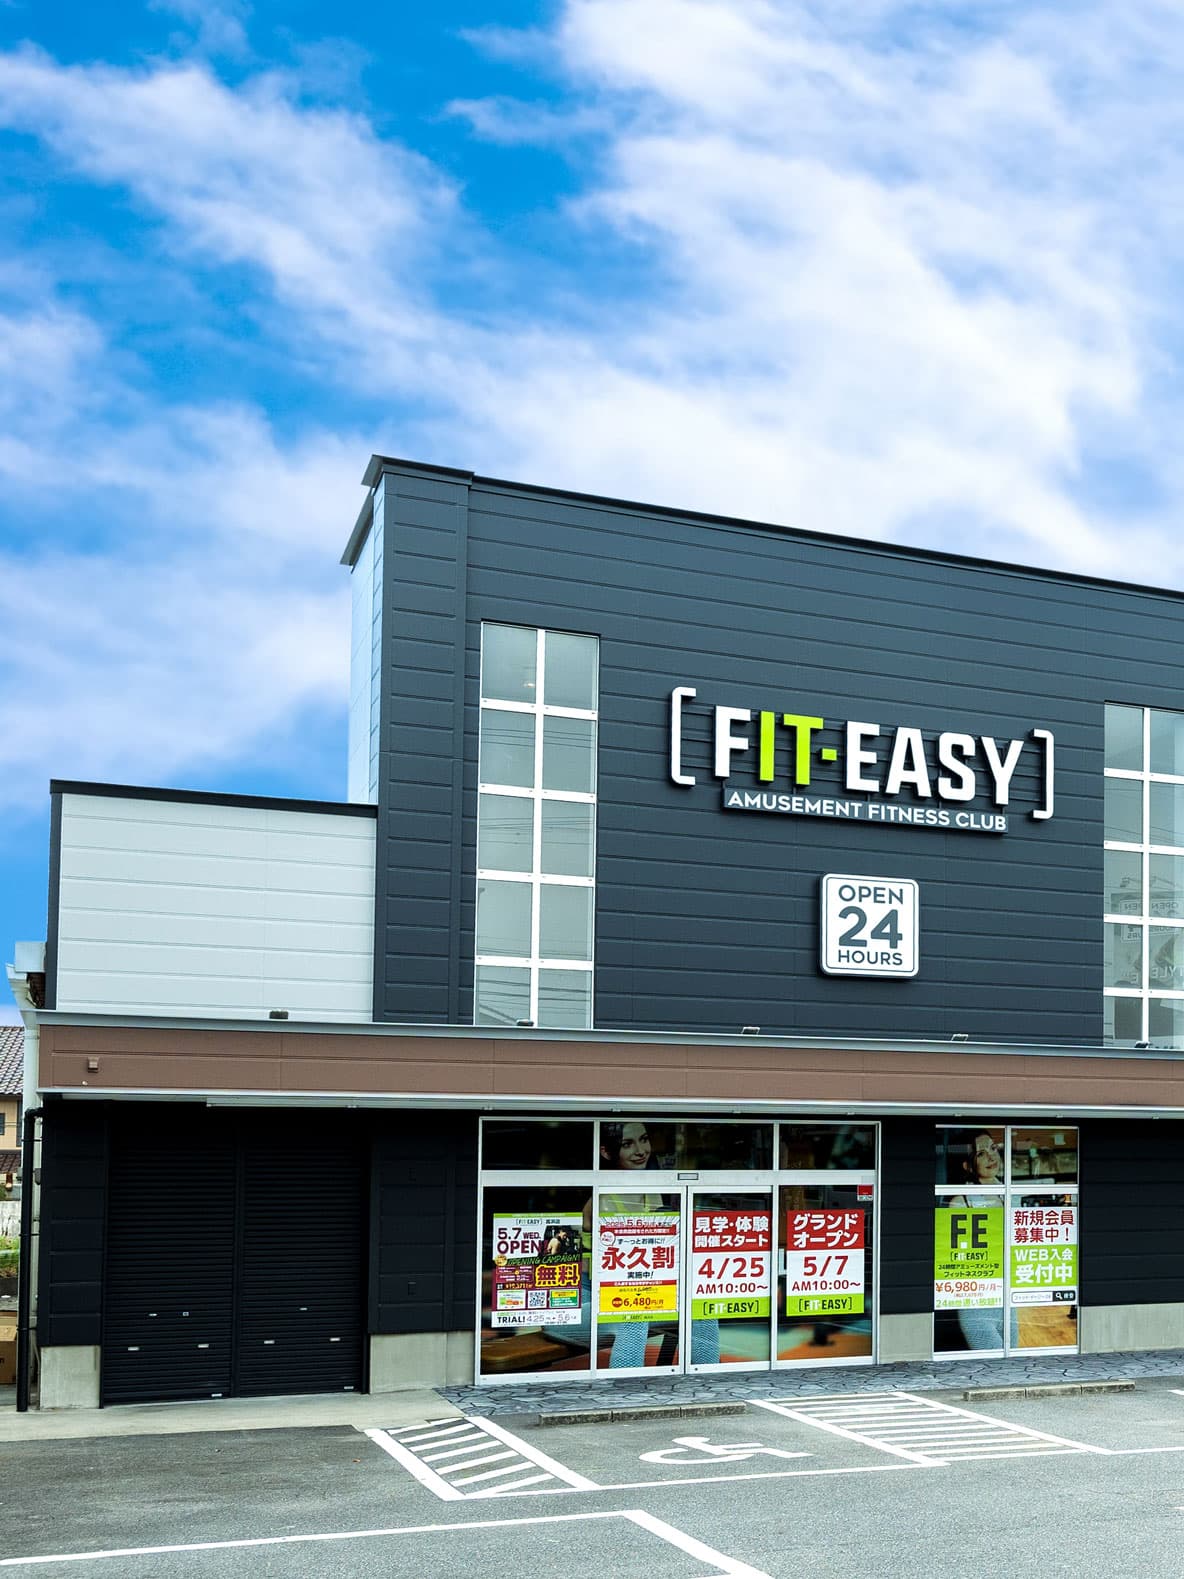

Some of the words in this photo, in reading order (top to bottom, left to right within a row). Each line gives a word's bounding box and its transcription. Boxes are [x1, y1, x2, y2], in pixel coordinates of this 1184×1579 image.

[727, 791, 862, 818] AMUSEMENT
[868, 804, 949, 826] FITNESS
[955, 813, 1007, 831] CLUB
[838, 884, 903, 905] OPEN
[838, 905, 903, 949] 24
[838, 949, 903, 966] HOURS
[694, 1215, 769, 1233] 見学・体験
[793, 1213, 859, 1231] グランド
[1014, 1210, 1074, 1226] 新規会員
[497, 1228, 522, 1240] 5.7
[694, 1234, 769, 1248] 開催スタート
[793, 1230, 859, 1248] オープン
[497, 1240, 541, 1254] OPEN
[1014, 1248, 1073, 1262] WEB入会
[601, 1246, 675, 1270] 永久割
[803, 1255, 849, 1277] 5/7
[535, 1264, 579, 1287] 無料
[698, 1256, 765, 1279] 4/25
[1015, 1263, 1073, 1284] 受付中
[497, 1315, 525, 1324] TRIAL!
